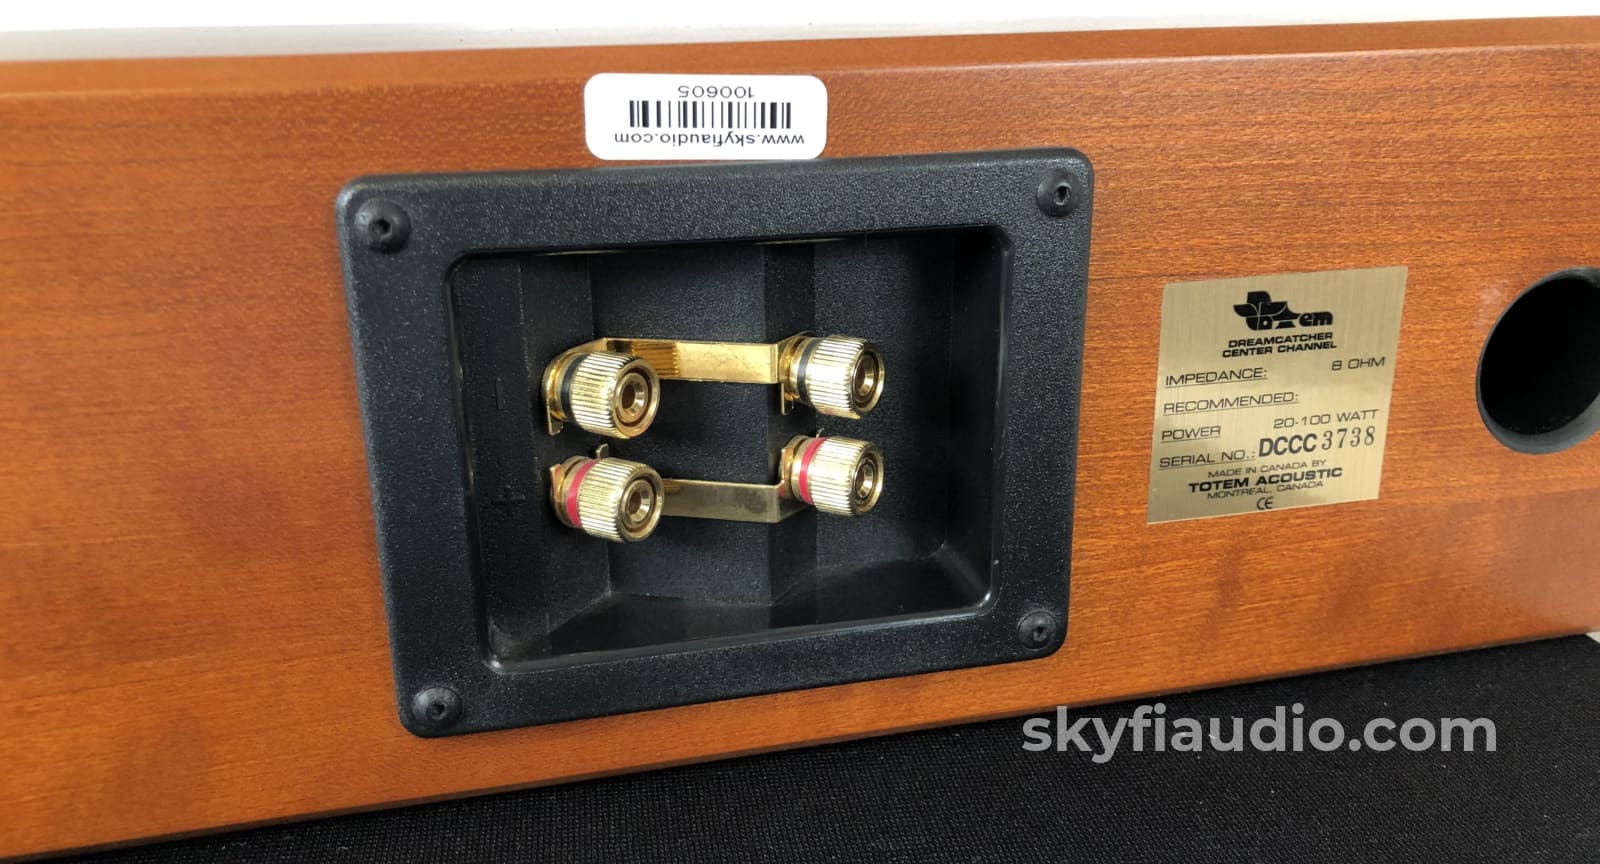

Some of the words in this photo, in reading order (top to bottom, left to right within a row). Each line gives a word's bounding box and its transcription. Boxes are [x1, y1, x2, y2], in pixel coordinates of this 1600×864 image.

[678, 85, 755, 98] 100605
[614, 131, 805, 147] www.skyfiaudio.com
[1222, 346, 1273, 358] CENTER
[1277, 341, 1337, 354] CHANNEL
[1228, 332, 1333, 348] DREAMCATCHER
[1165, 367, 1268, 386] IMPEDANCE:
[1331, 360, 1342, 371] 8
[1347, 356, 1385, 369] OHM
[1163, 391, 1299, 413] RECOMMENDED:
[1161, 426, 1221, 441] POWER
[1273, 414, 1331, 429] 20-100
[1337, 409, 1379, 423] WATT
[1159, 452, 1215, 468] SERIAL
[1258, 433, 1317, 457] DCCC
[1322, 425, 1376, 450] 3738
[1208, 468, 1242, 478] MADE
[1245, 466, 1257, 475] IN
[1260, 461, 1308, 473] CANADA
[1312, 459, 1327, 467] BY
[1189, 477, 1249, 493] TOTEM
[1255, 467, 1343, 485] ACOUSTIC
[1277, 480, 1323, 492] CANADA
